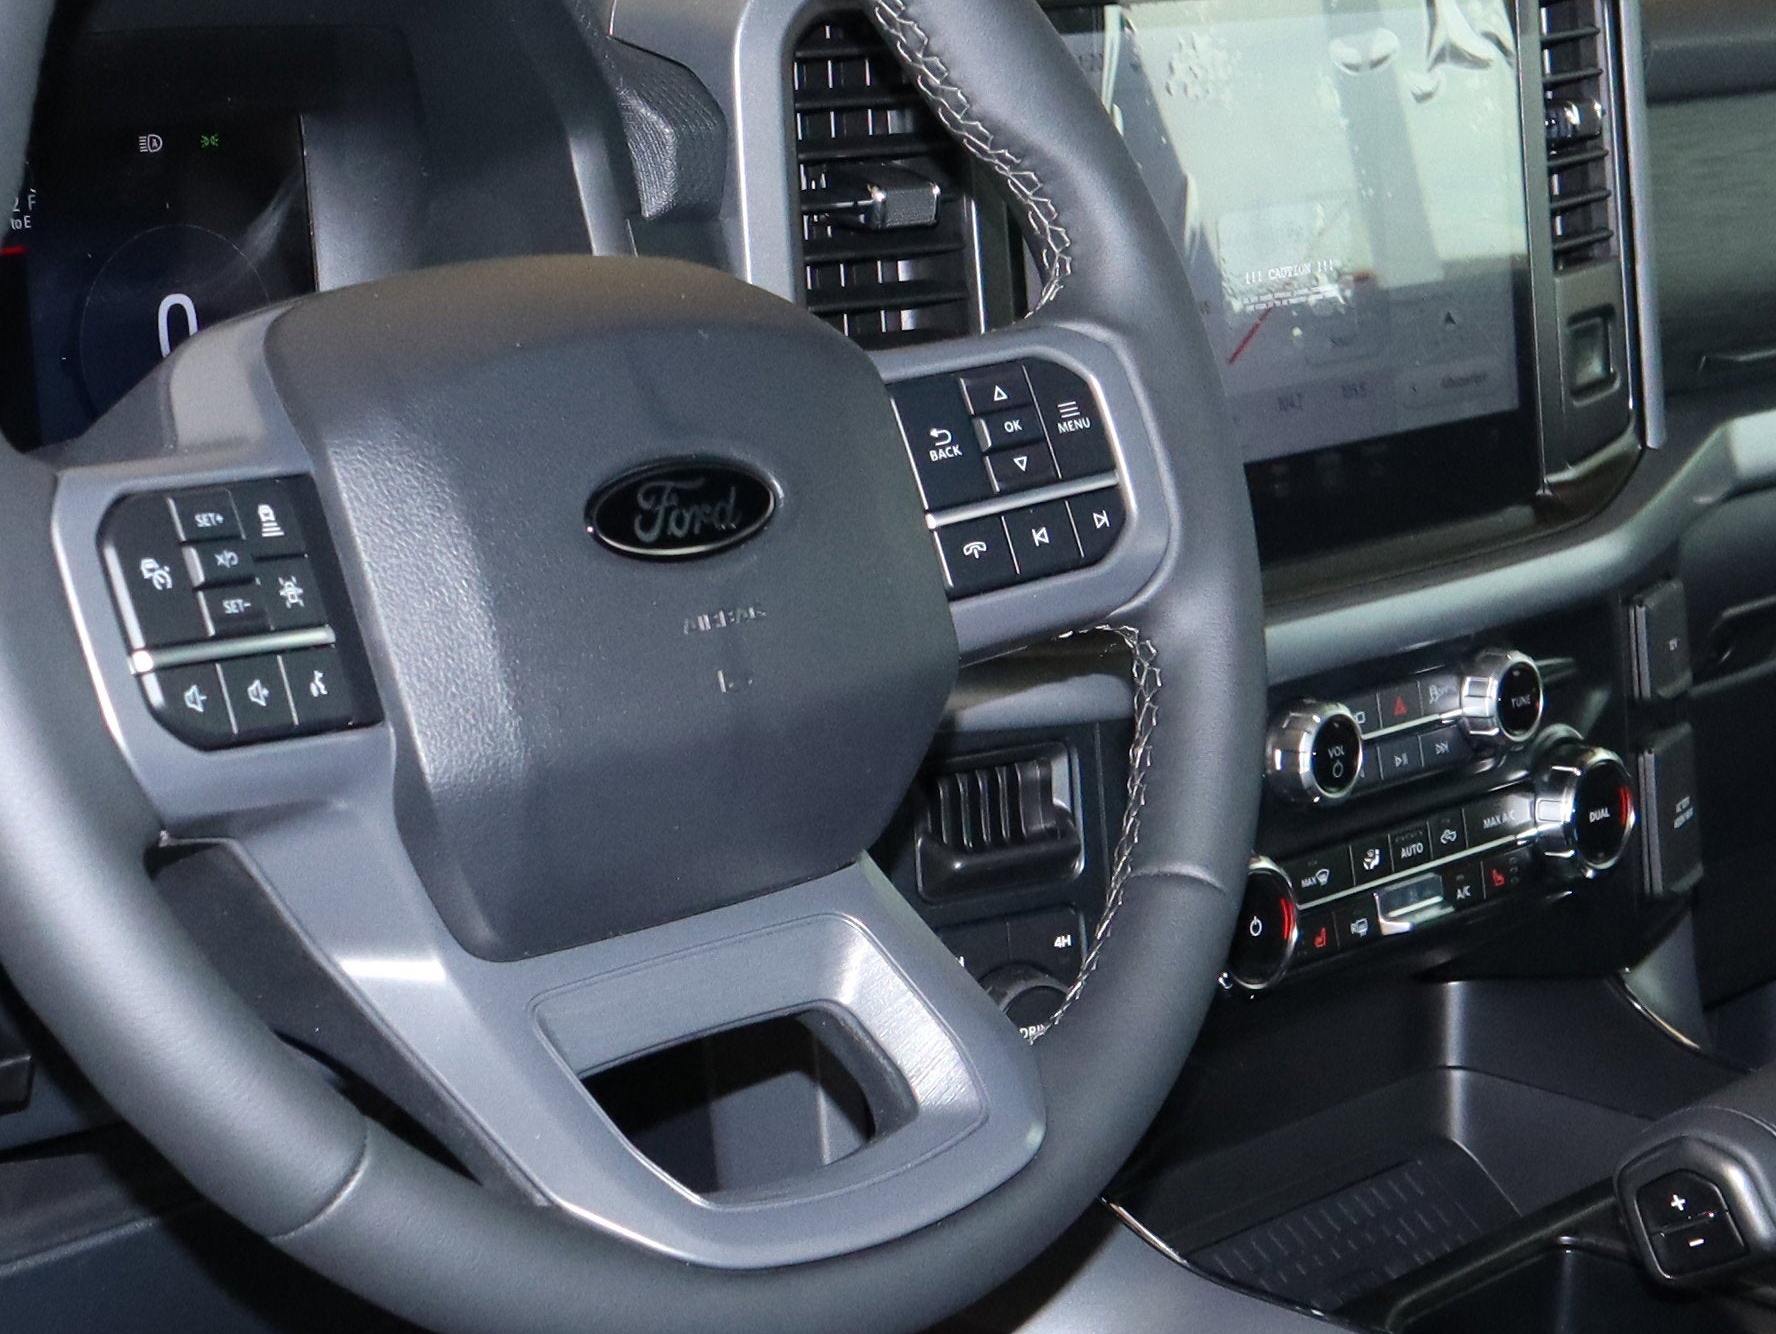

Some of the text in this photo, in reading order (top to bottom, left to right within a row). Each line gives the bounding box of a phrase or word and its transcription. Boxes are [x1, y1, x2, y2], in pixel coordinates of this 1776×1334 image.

[28, 195, 36, 211] F
[1268, 263, 1312, 280] CAUTION
[158, 293, 199, 359] 0
[1004, 419, 1023, 433] OK
[1057, 417, 1091, 434] MENU
[928, 444, 963, 462] BACK
[634, 476, 739, 543] Ford
[1511, 695, 1532, 708] TUNE
[1483, 815, 1502, 829] MAX
[1589, 807, 1611, 823] DUAL
[1401, 842, 1424, 859] AUTO
[1301, 876, 1318, 888] MAX
[1456, 884, 1472, 899] A/C
[1054, 934, 1072, 948] 4H
